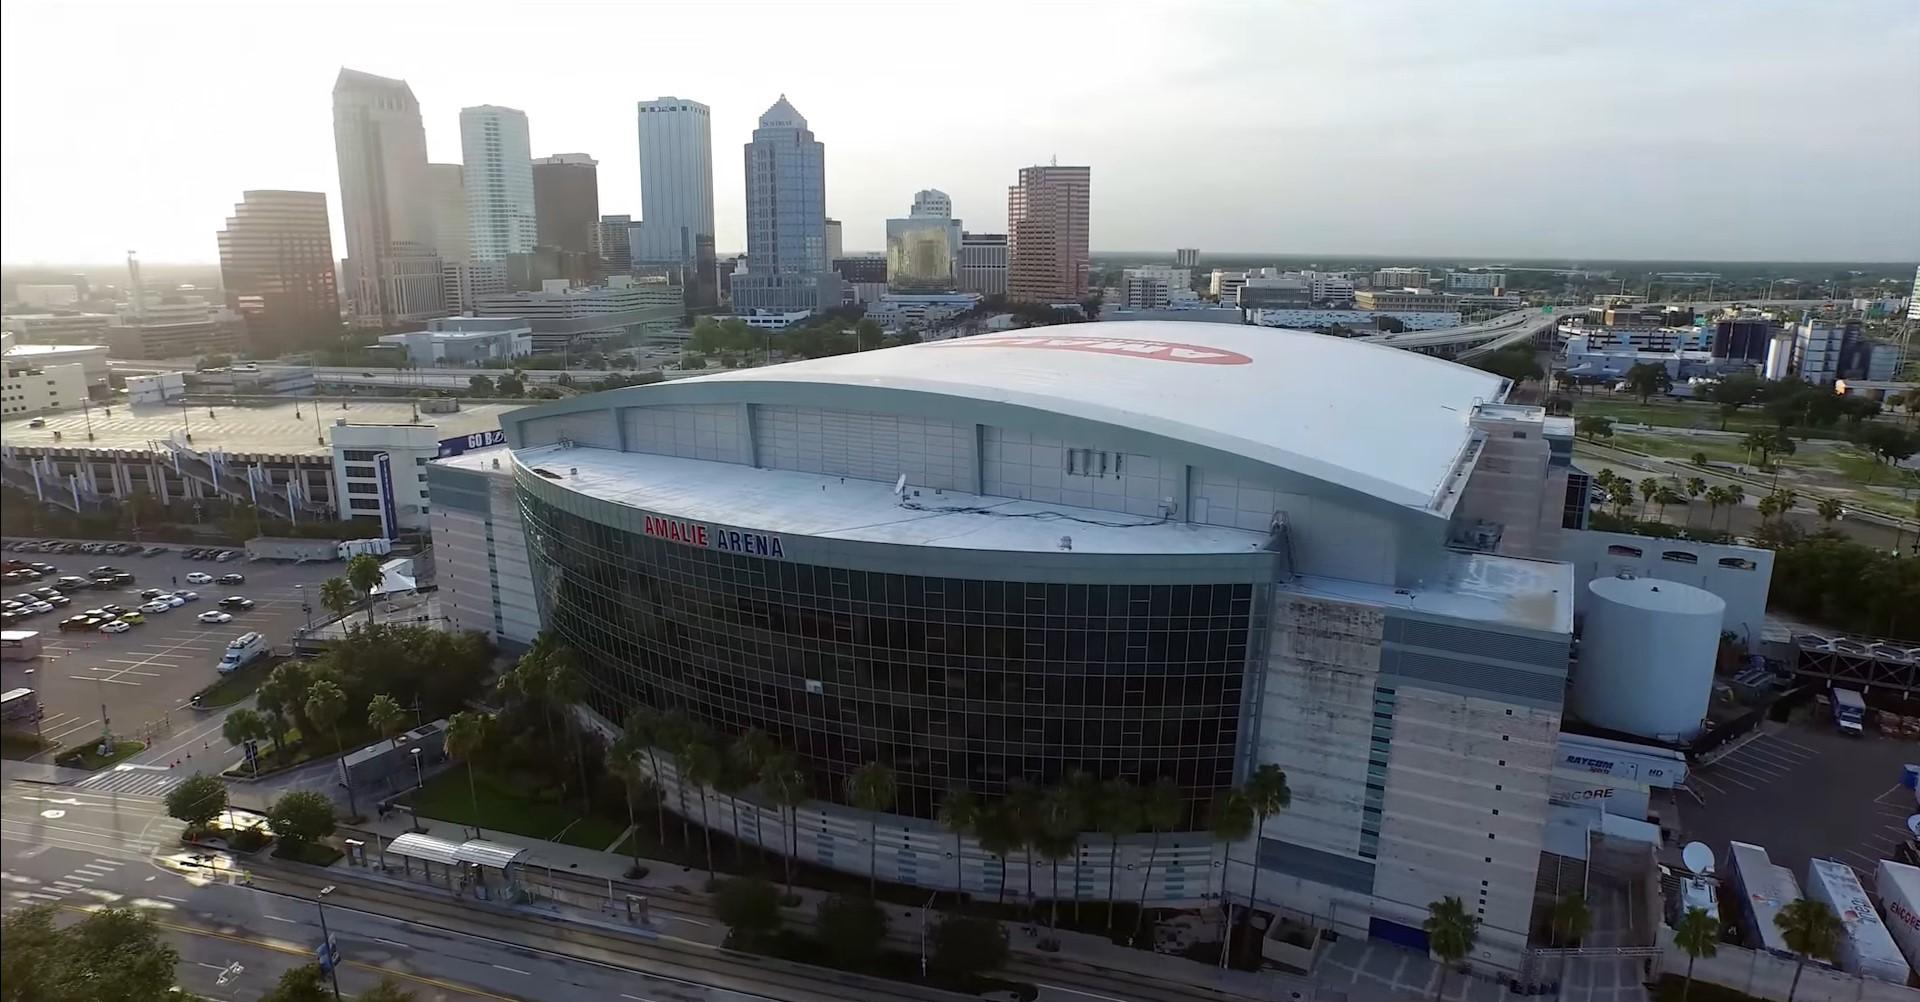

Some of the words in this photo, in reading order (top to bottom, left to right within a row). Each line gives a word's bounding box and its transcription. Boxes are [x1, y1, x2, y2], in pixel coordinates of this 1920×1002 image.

[467, 433, 483, 448] GO
[645, 514, 710, 550] AMALIE
[717, 527, 786, 559] ARENA
[1566, 755, 1614, 769] RAYCOM
[1648, 768, 1664, 777] HD
